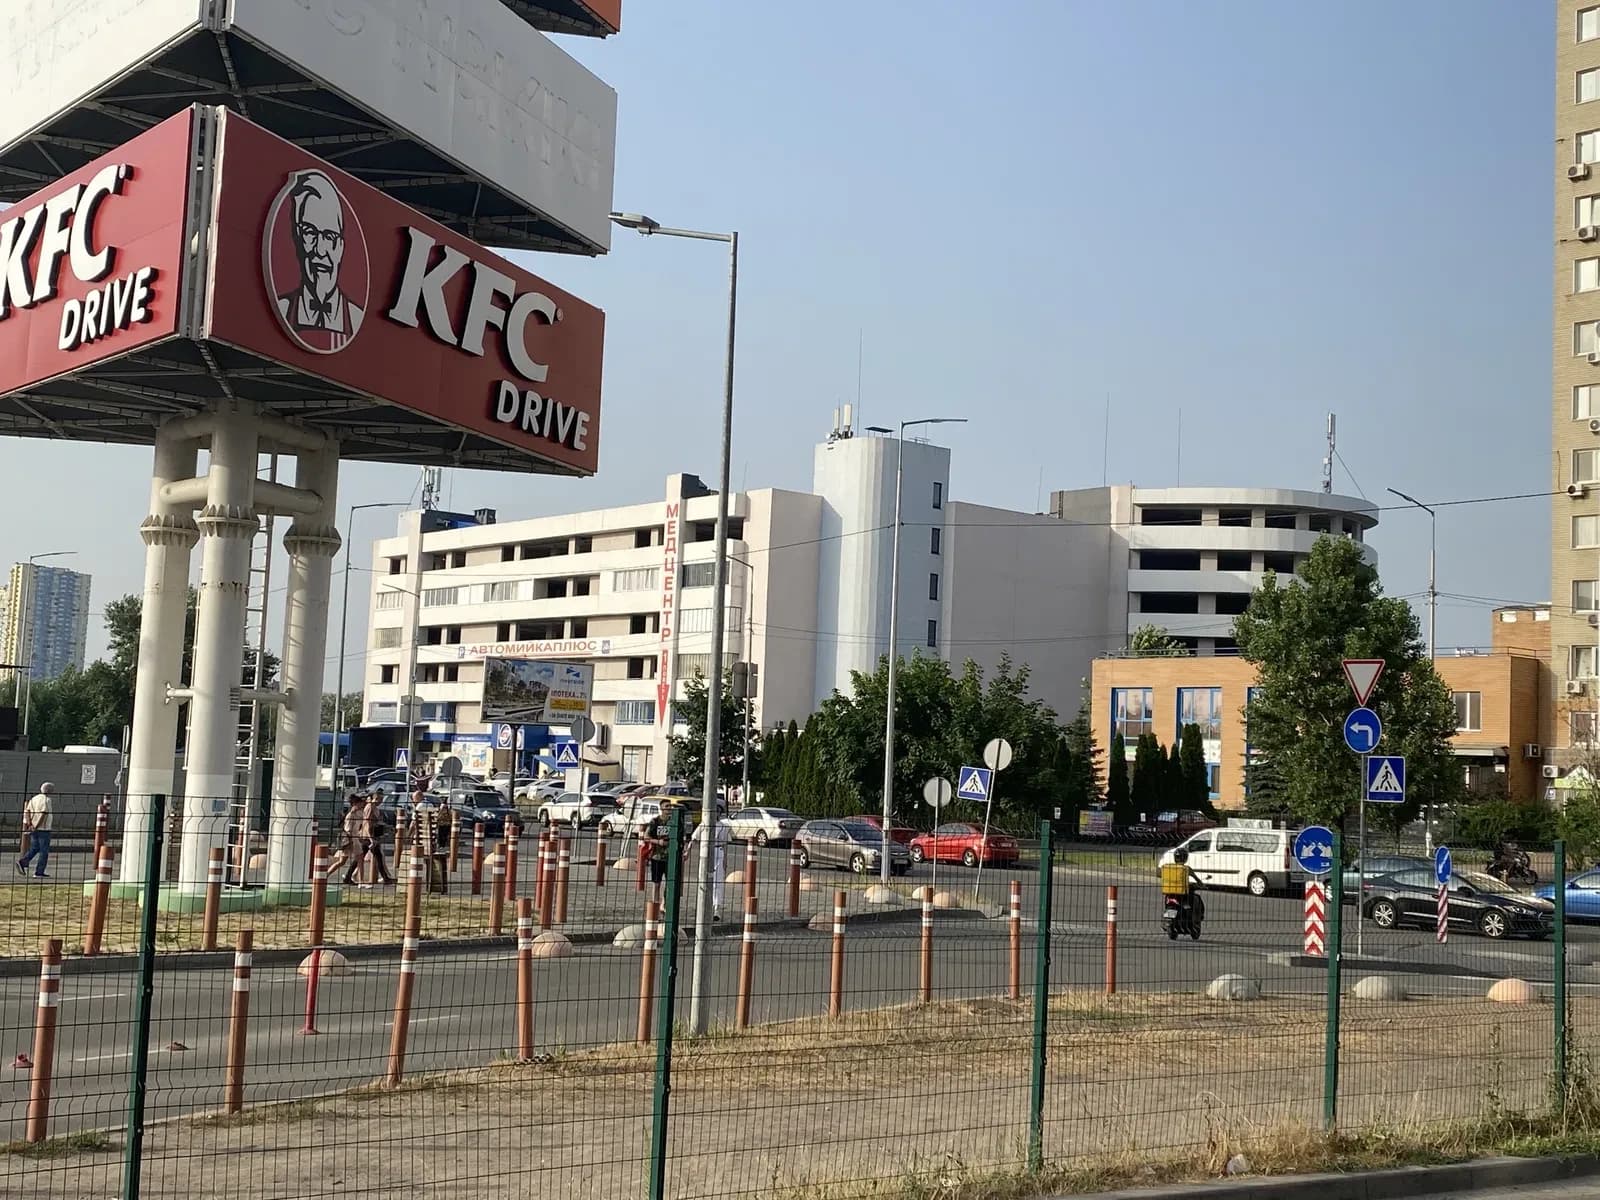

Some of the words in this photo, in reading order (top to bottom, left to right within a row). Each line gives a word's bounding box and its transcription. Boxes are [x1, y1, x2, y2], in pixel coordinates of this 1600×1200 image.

[58, 266, 152, 350] DRIVE
[389, 226, 558, 383] KFC
[497, 380, 591, 451] DRIVE
[660, 503, 679, 643] МЕДЦЕНТР
